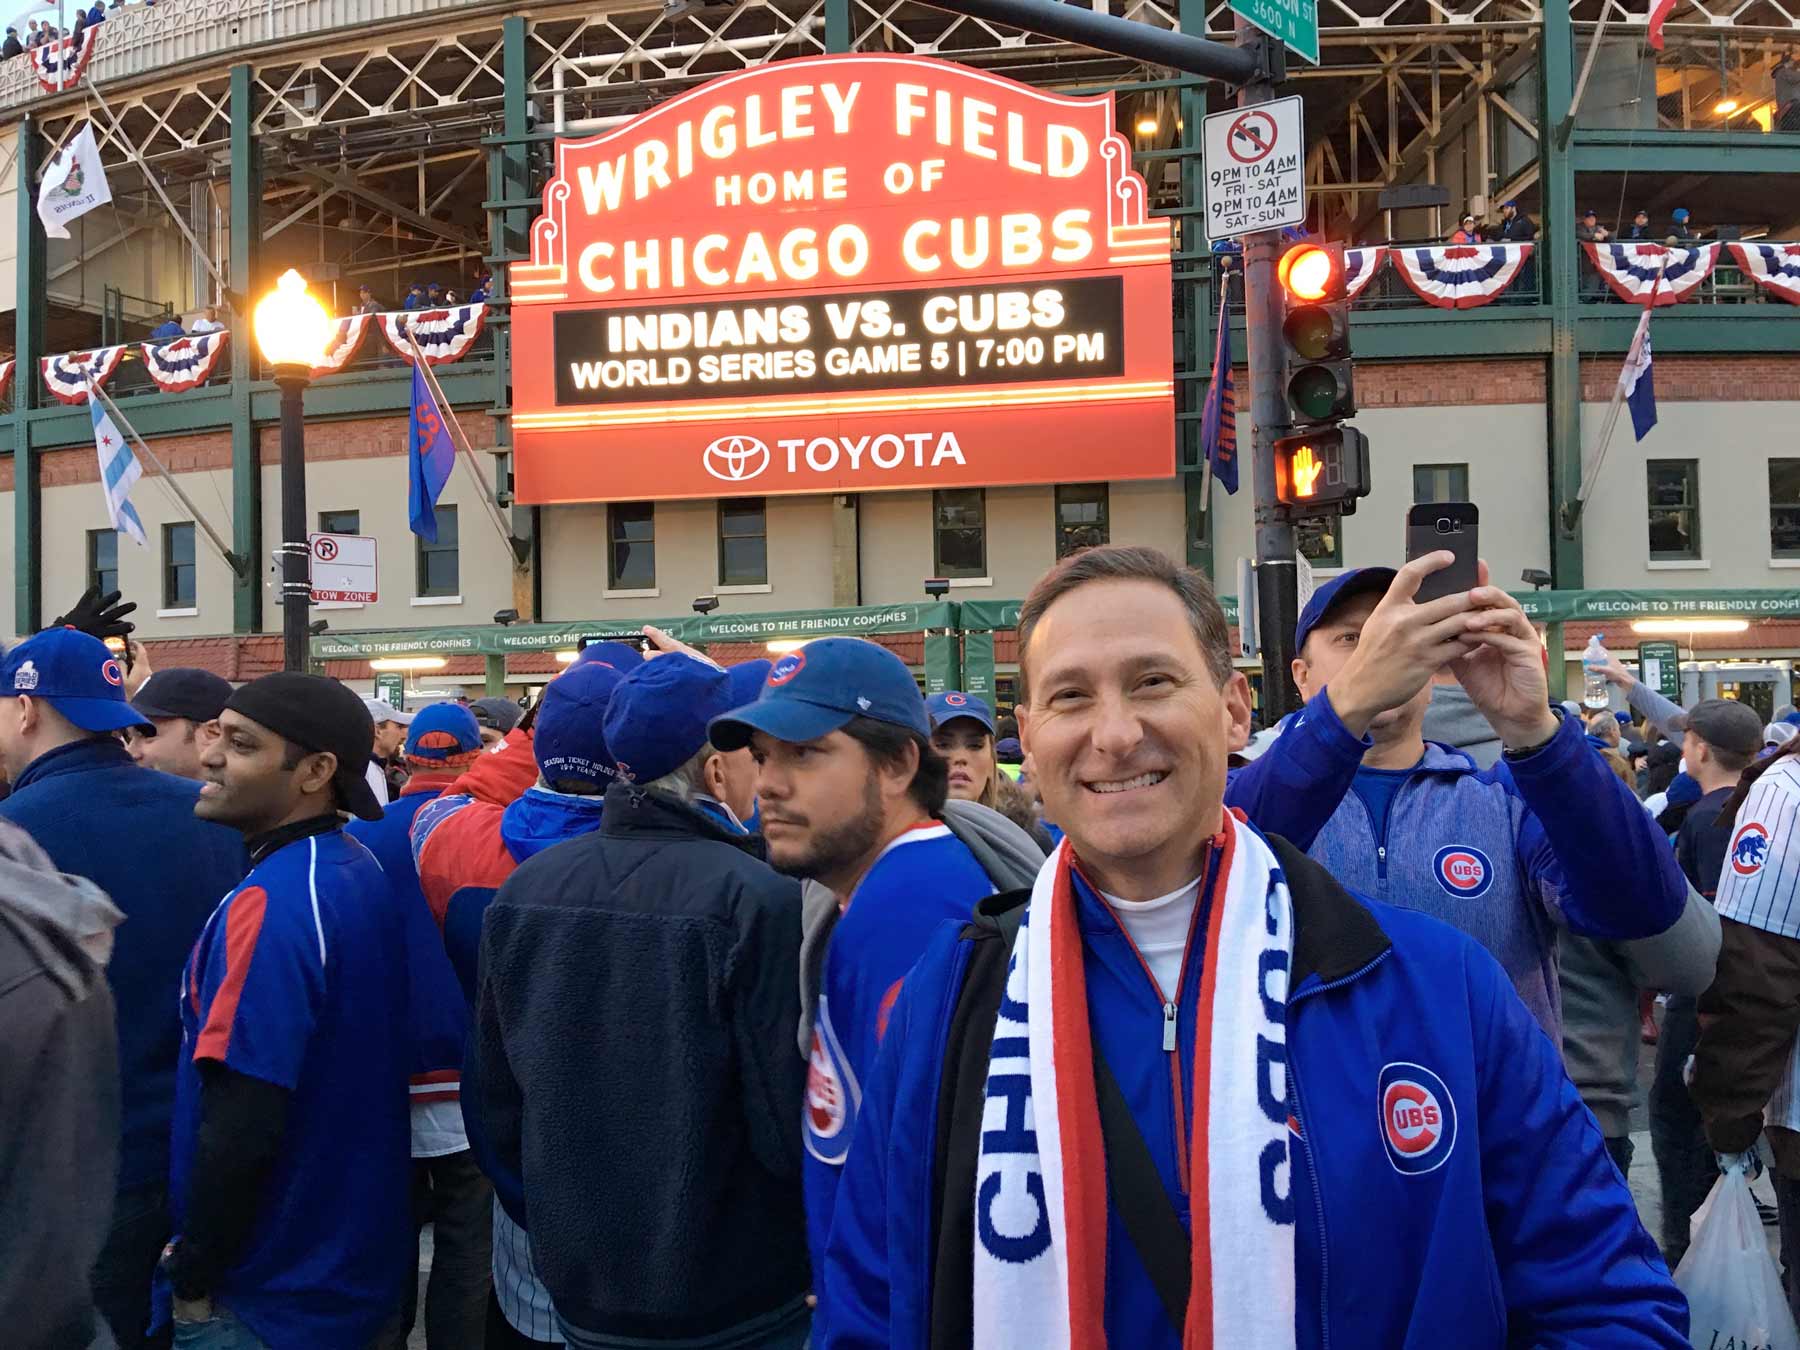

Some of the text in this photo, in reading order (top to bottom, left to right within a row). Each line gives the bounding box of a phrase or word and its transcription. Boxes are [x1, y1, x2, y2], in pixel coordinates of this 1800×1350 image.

[1252, 0, 1296, 39] 3600 N
[1302, 2, 1312, 23] ST
[577, 82, 1089, 216] WRIGLEY FIELD
[1245, 165, 1260, 178] TO
[1264, 155, 1296, 175] 4AM
[715, 159, 945, 206] HOME OF
[1226, 184, 1245, 197] FRI
[1258, 176, 1281, 190] SAT
[1246, 196, 1261, 210] TO
[1265, 186, 1297, 207] 4AM
[1226, 215, 1249, 228] SAT
[1259, 207, 1285, 221] SUN
[579, 209, 1093, 292] CHICAGO CUBS
[608, 289, 1065, 353] INDIANS VS. CUBS
[571, 357, 692, 389] WORLD
[698, 350, 816, 383] SERIES
[825, 343, 921, 376] GAME
[930, 342, 950, 370] 5
[976, 337, 1044, 367] 7:00
[1053, 333, 1104, 363] PM
[777, 432, 967, 473] TOYOTA
[315, 591, 373, 601] TOW ZONE
[1587, 601, 1648, 611] WELCOME
[1652, 602, 1669, 611] TO
[1672, 601, 1696, 611] THE
[1699, 600, 1757, 611] FRIENDLY
[710, 611, 907, 634] WELCOME TO THE FRIENDLY CONFINES
[362, 644, 372, 652] TO
[374, 643, 390, 652] THE
[391, 641, 429, 651] FRIENDLY
[430, 638, 471, 649] CONFINES
[503, 636, 546, 646] WELCOME
[549, 636, 560, 644] TO
[563, 634, 579, 643] THE
[568, 756, 590, 767] TICKET
